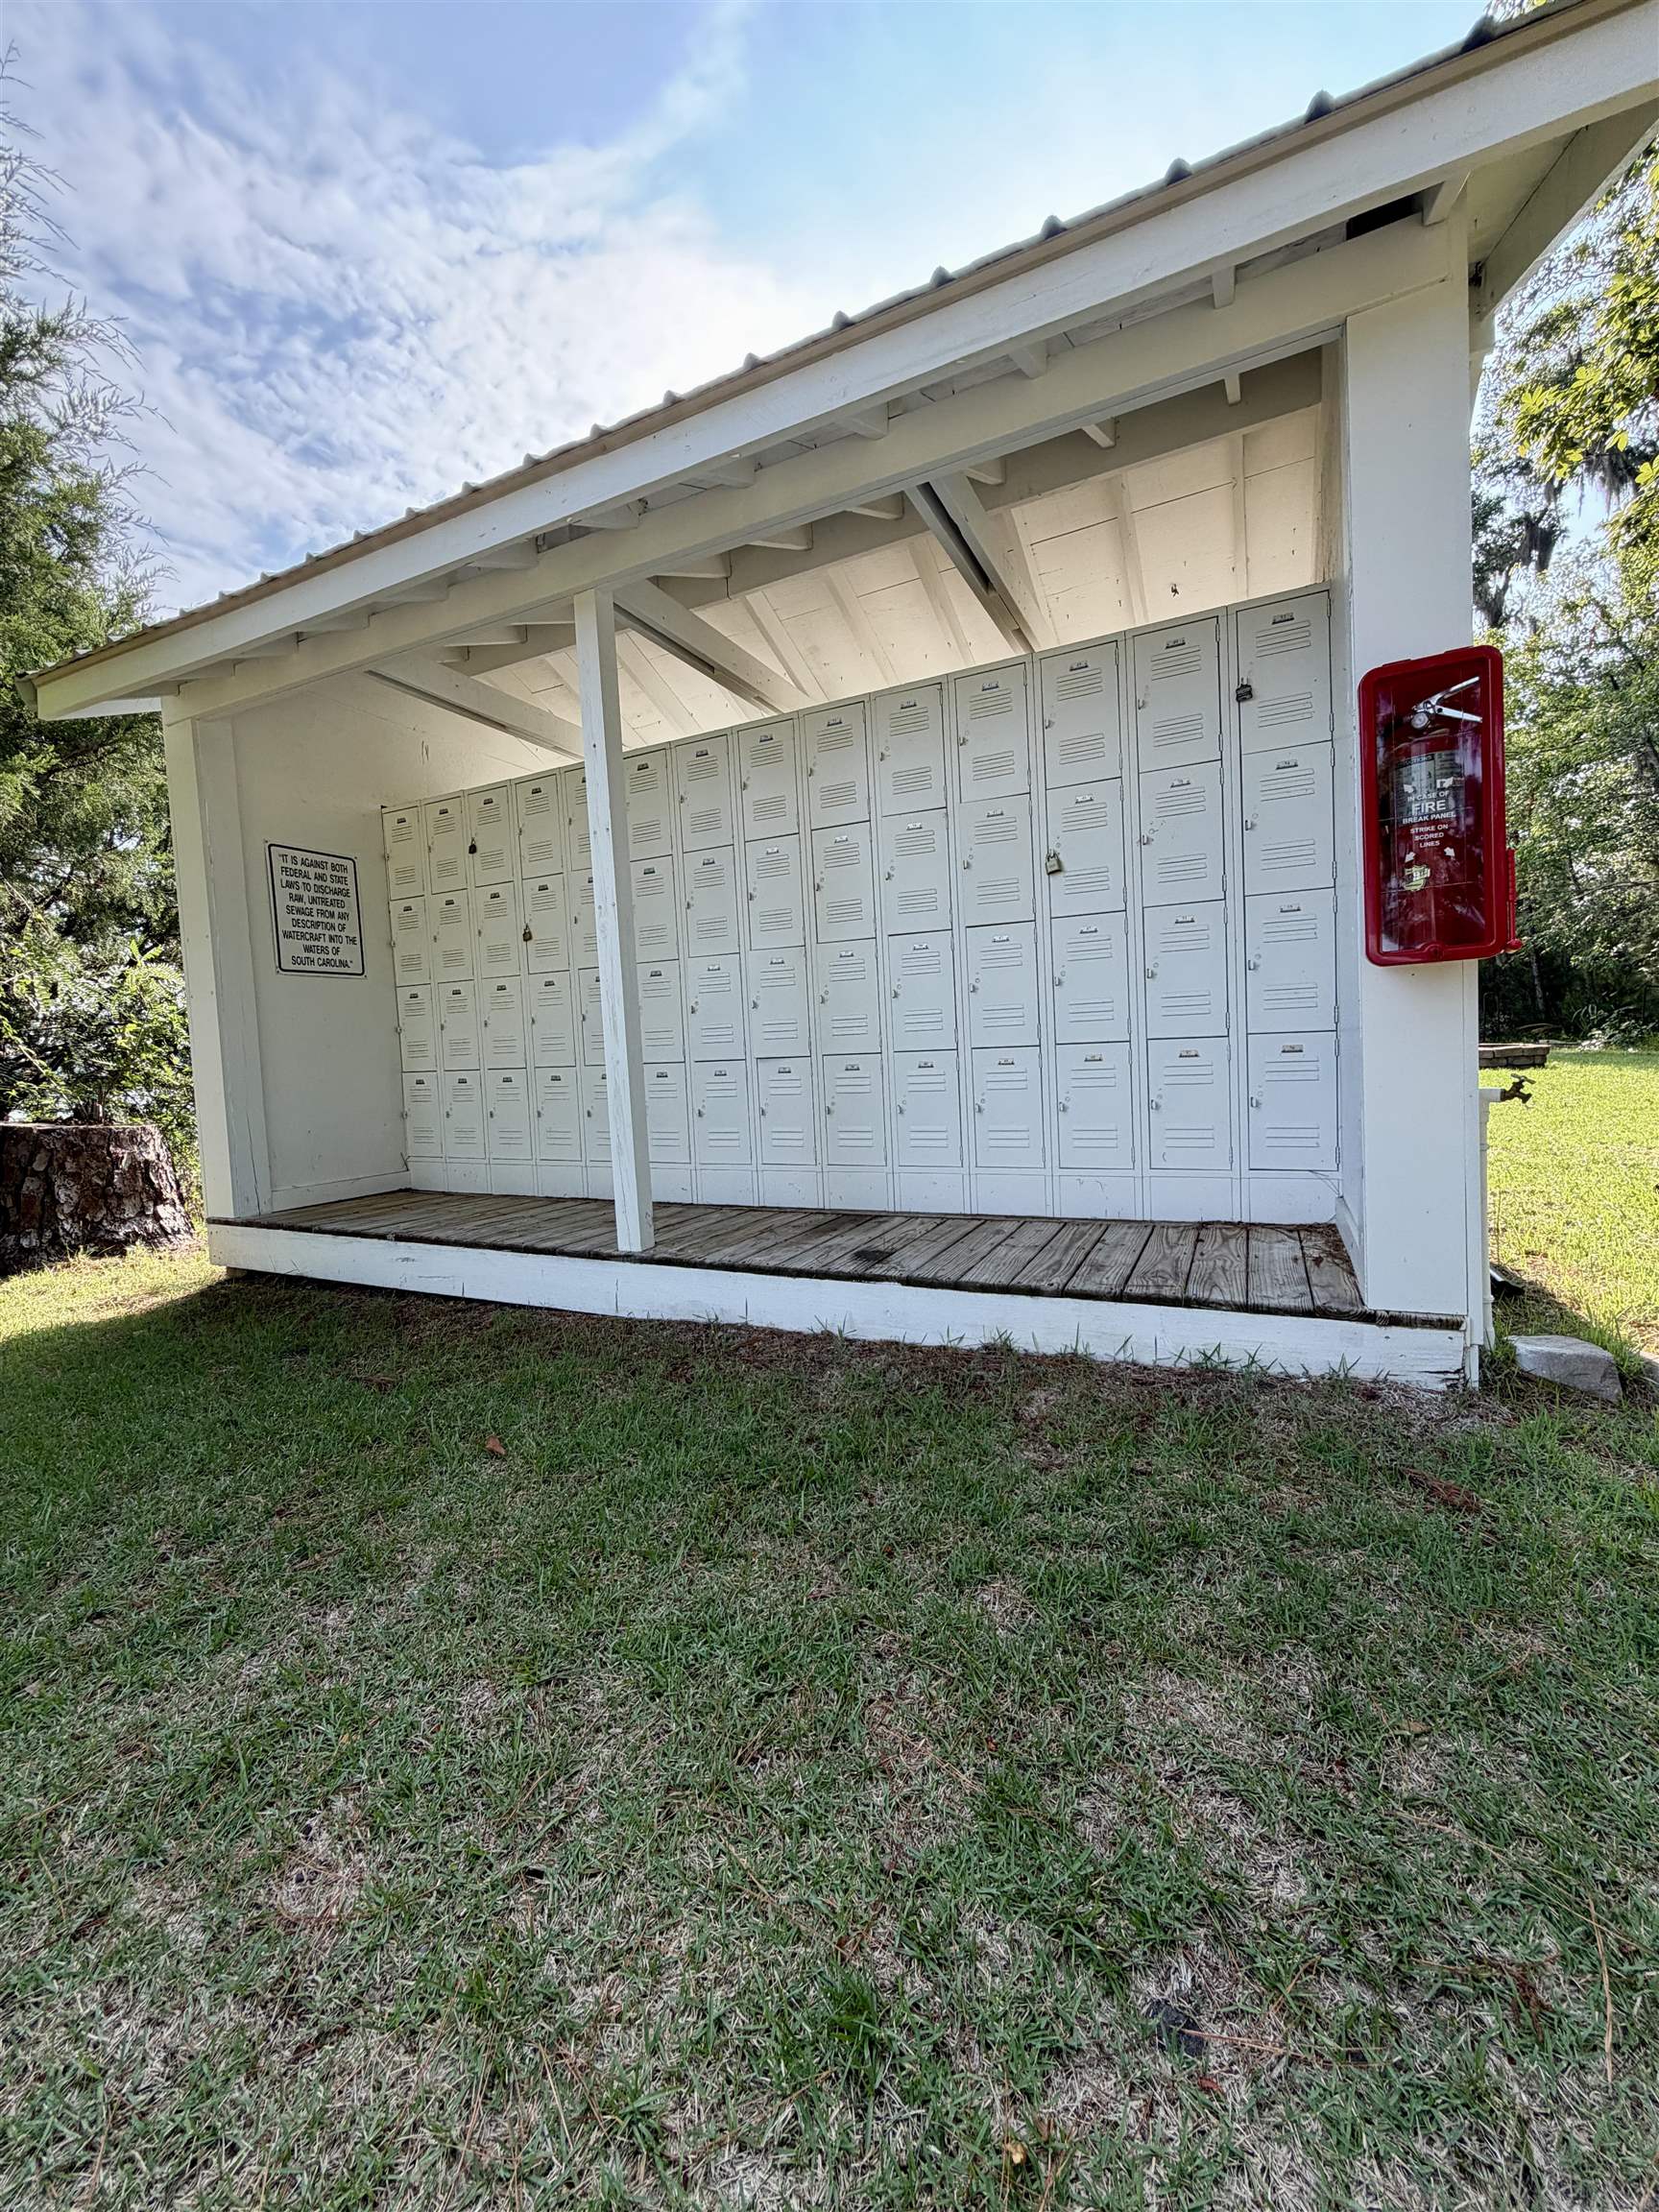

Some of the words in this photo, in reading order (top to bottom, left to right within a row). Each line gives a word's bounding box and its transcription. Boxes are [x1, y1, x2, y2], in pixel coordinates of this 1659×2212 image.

[1412, 800, 1446, 816] FIRE
[1403, 815, 1429, 824] BREAK
[278, 854, 288, 863] "IT
[291, 856, 298, 865] IS
[301, 857, 328, 871] AGAINST
[331, 863, 348, 874] BOTH
[280, 867, 311, 879] FEDERAL
[314, 872, 327, 882] AND
[330, 875, 349, 885] STATE
[280, 879, 300, 890] LAWS
[301, 882, 311, 892] TO
[314, 885, 350, 898] DISCHARGE
[289, 893, 305, 904] RAW,
[308, 896, 345, 908] UNTREATED
[286, 905, 314, 916] SEWAGE
[317, 908, 335, 919] FROM
[337, 912, 349, 921] ANY
[292, 919, 335, 930] DESCRIPTION
[338, 923, 347, 932] OF
[282, 929, 326, 943] WATERCRAFT
[328, 935, 344, 944] INTO
[346, 936, 357, 945] THE
[302, 944, 329, 954] WATERS
[331, 947, 340, 955] OF
[292, 955, 315, 966] SOUTH
[317, 958, 353, 968] CAROLINA."
